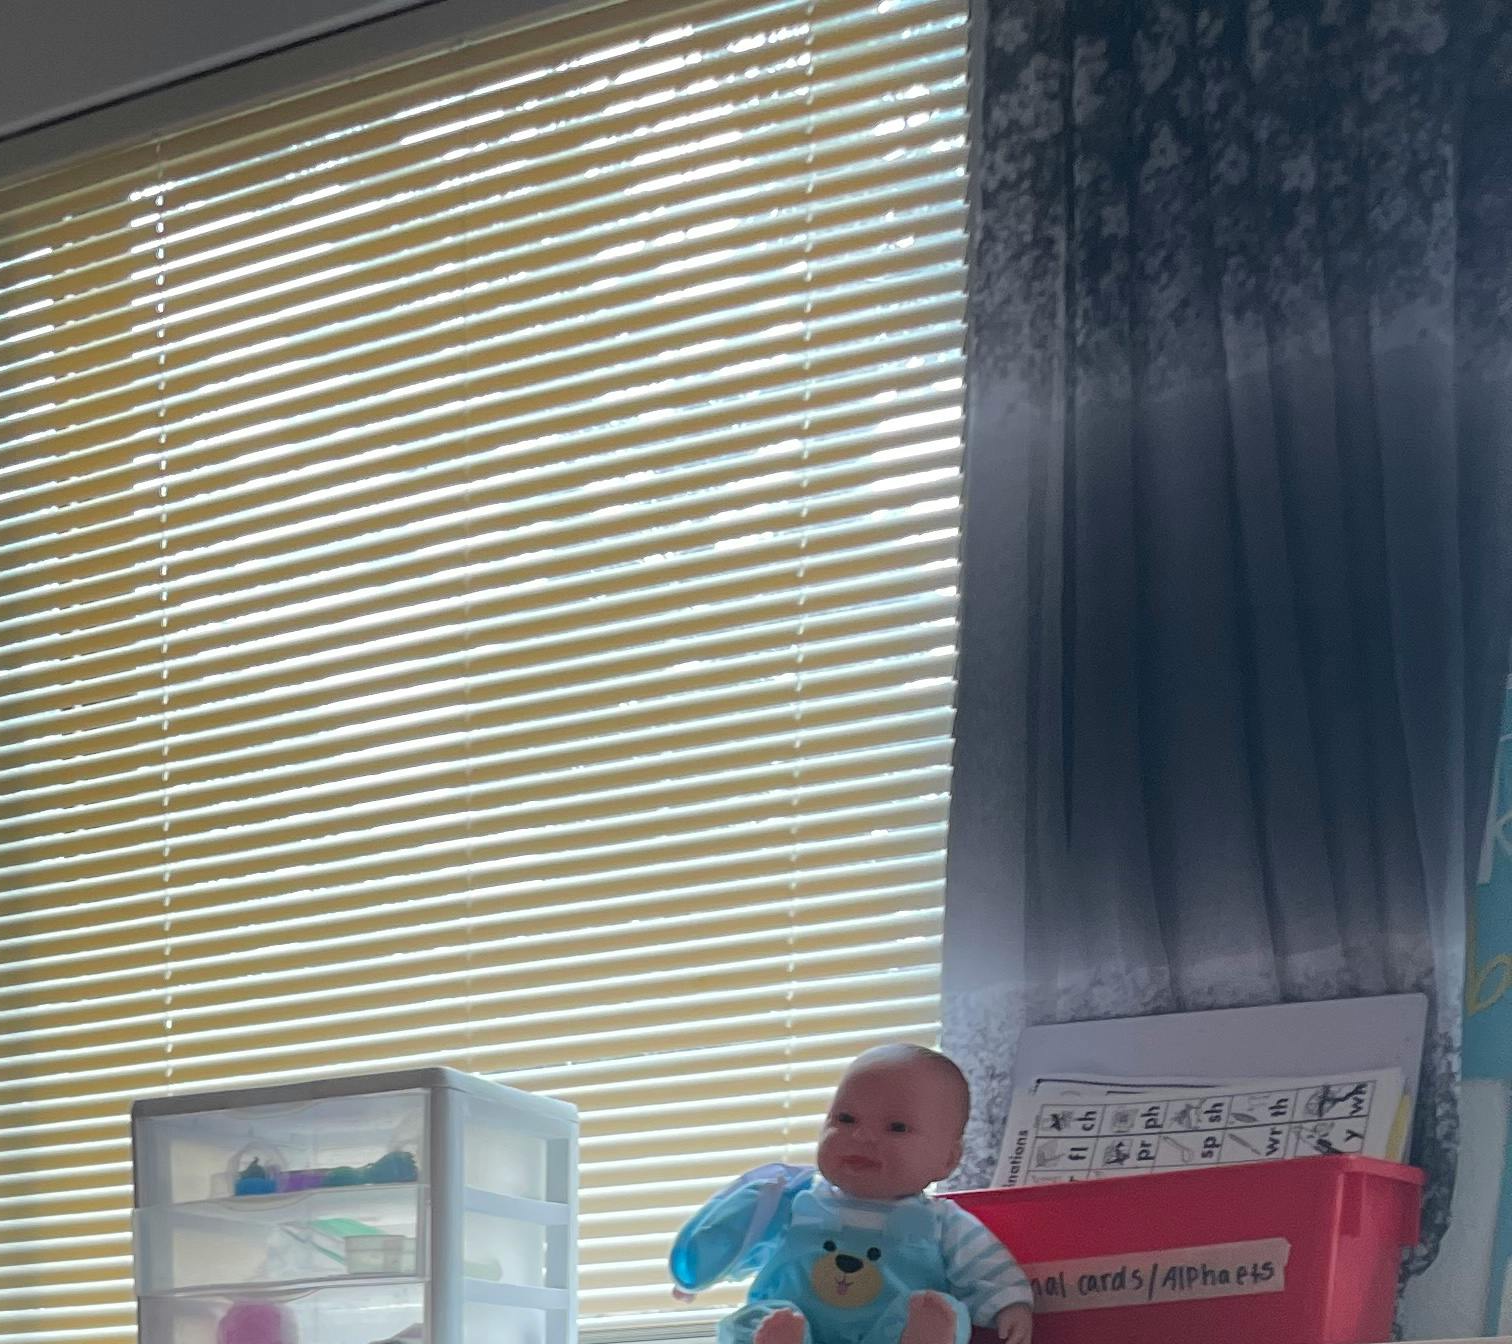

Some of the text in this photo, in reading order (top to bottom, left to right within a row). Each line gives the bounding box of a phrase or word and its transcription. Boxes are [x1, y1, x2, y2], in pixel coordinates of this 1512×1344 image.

[1072, 1110, 1097, 1131] ch
[1140, 1105, 1164, 1130] ph
[1203, 1102, 1224, 1123] sh
[1136, 1139, 1156, 1161] pr
[1200, 1135, 1222, 1159] sp
[1265, 1127, 1283, 1156] wr
